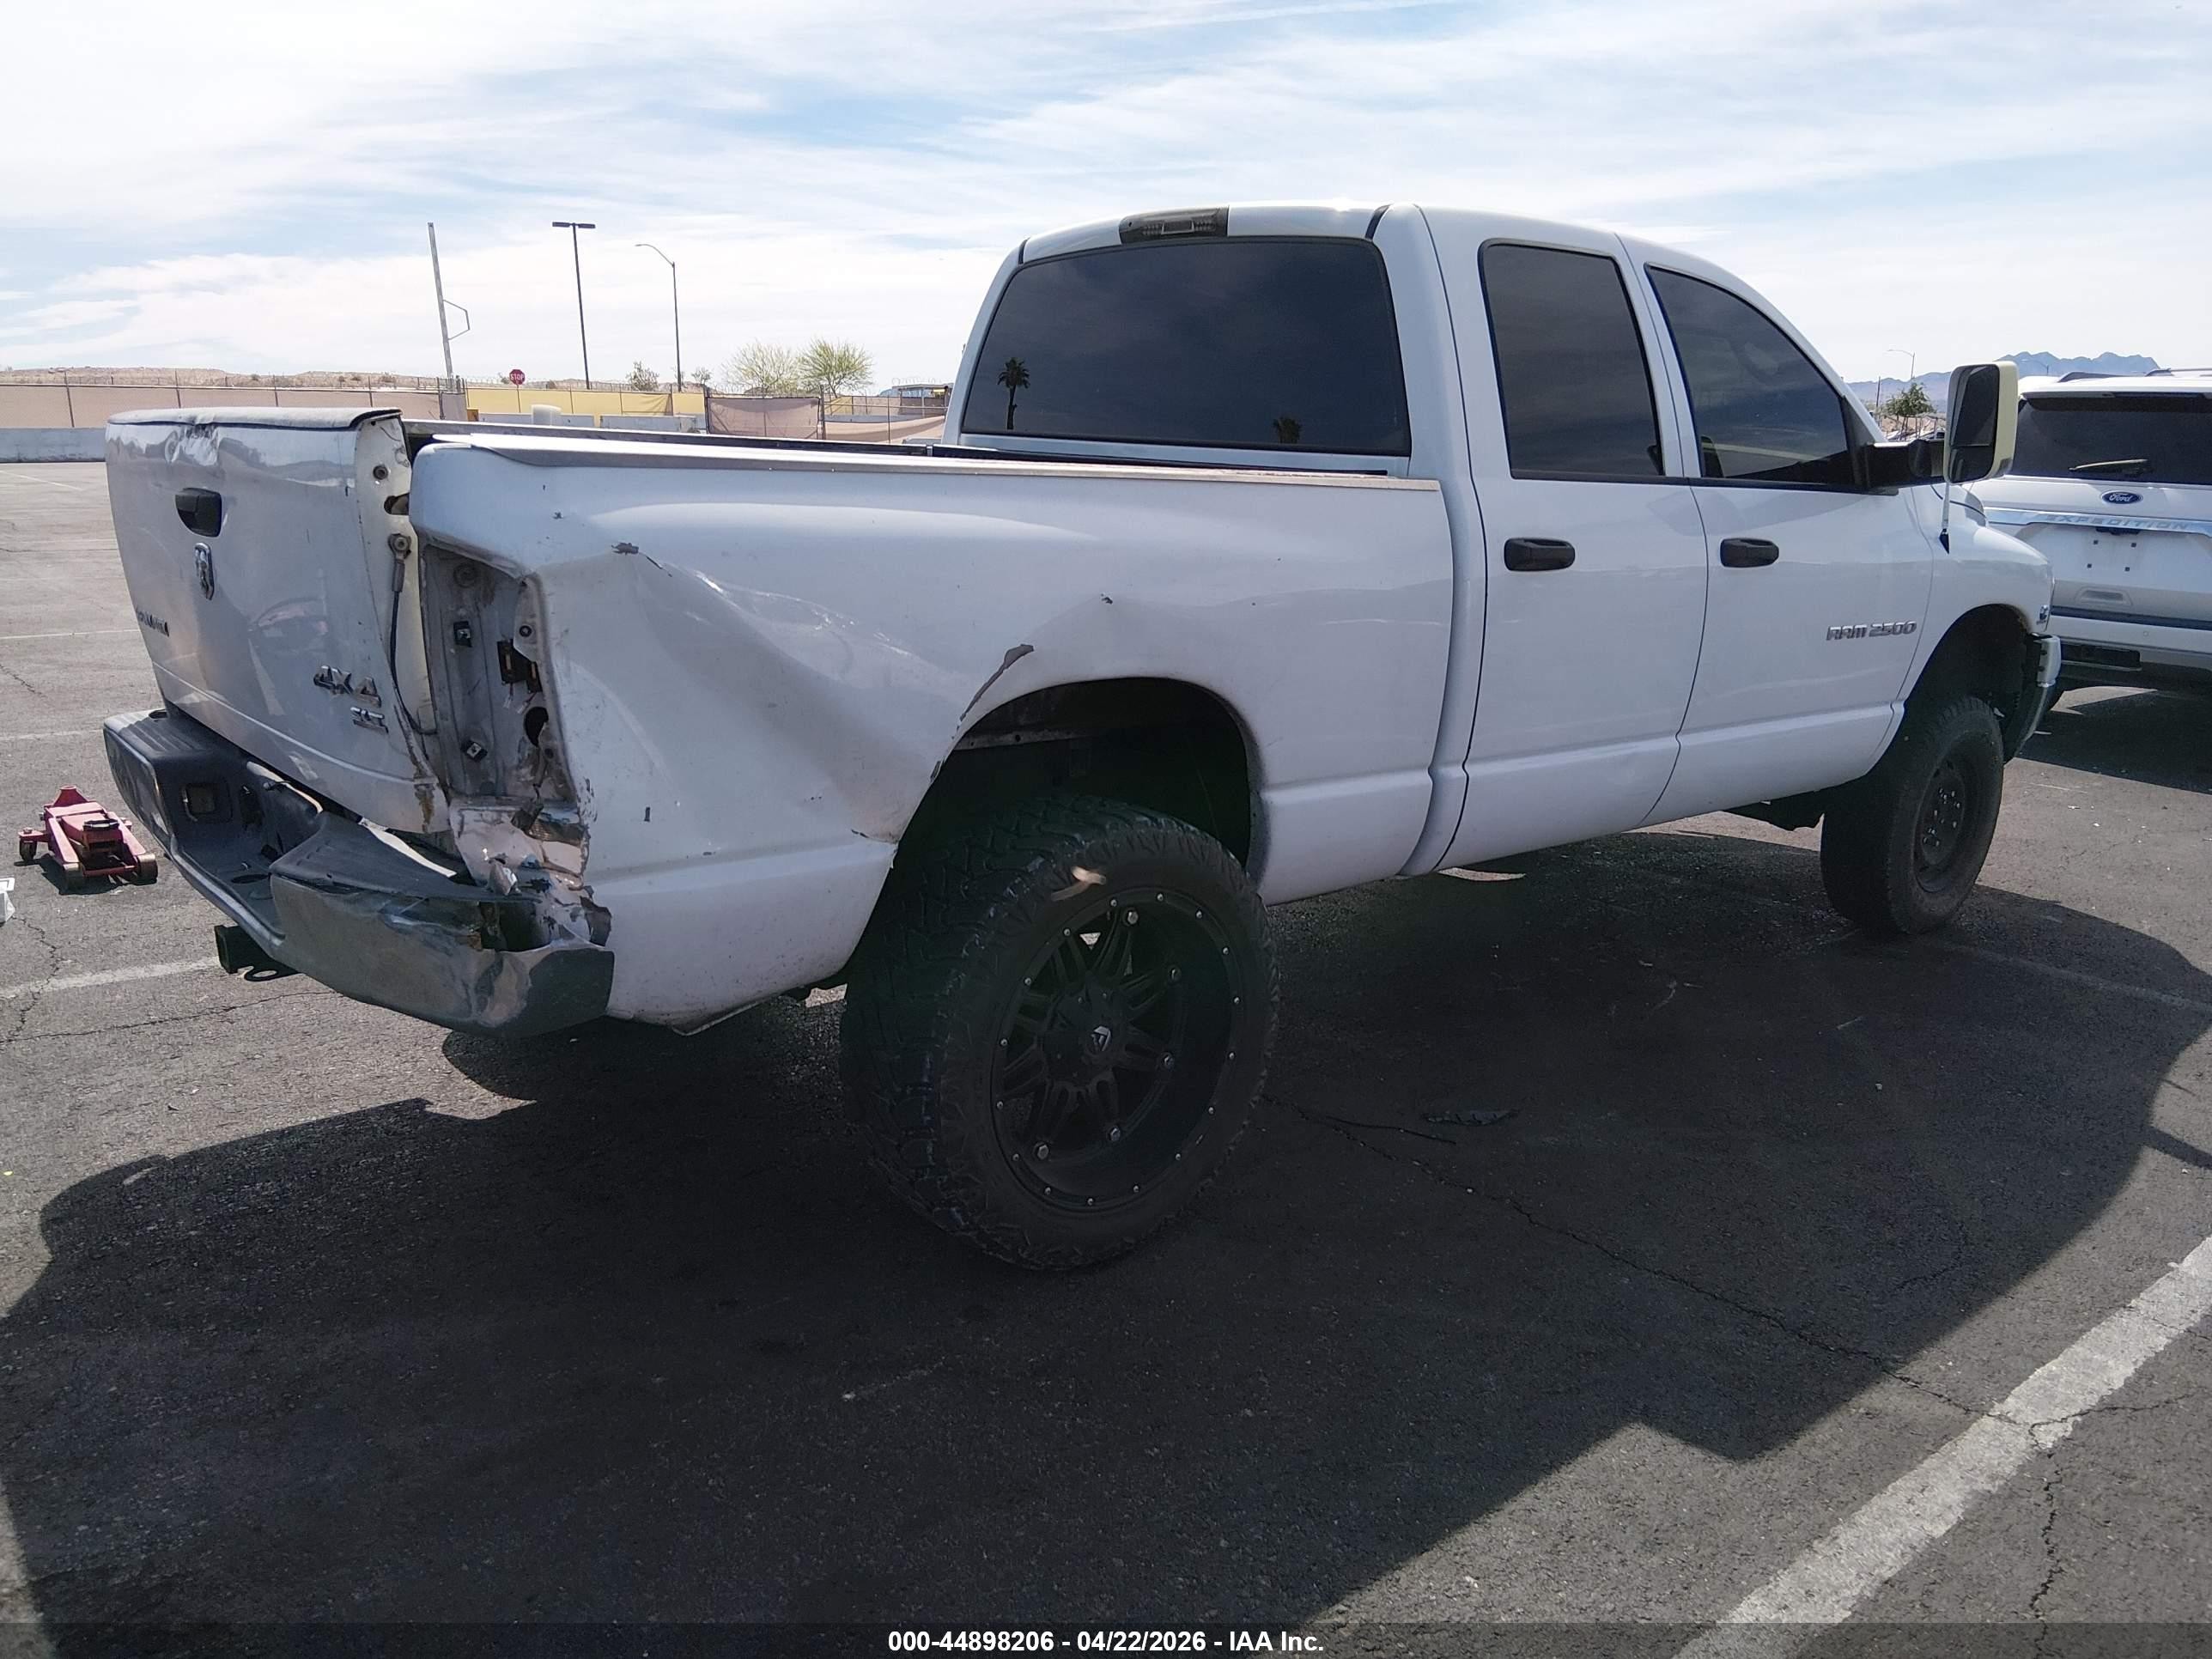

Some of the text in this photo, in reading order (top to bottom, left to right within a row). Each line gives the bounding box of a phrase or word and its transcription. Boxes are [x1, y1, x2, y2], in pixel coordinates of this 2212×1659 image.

[2046, 514, 2189, 530] EXPEDITION
[1826, 621, 1917, 641] RAM 2500
